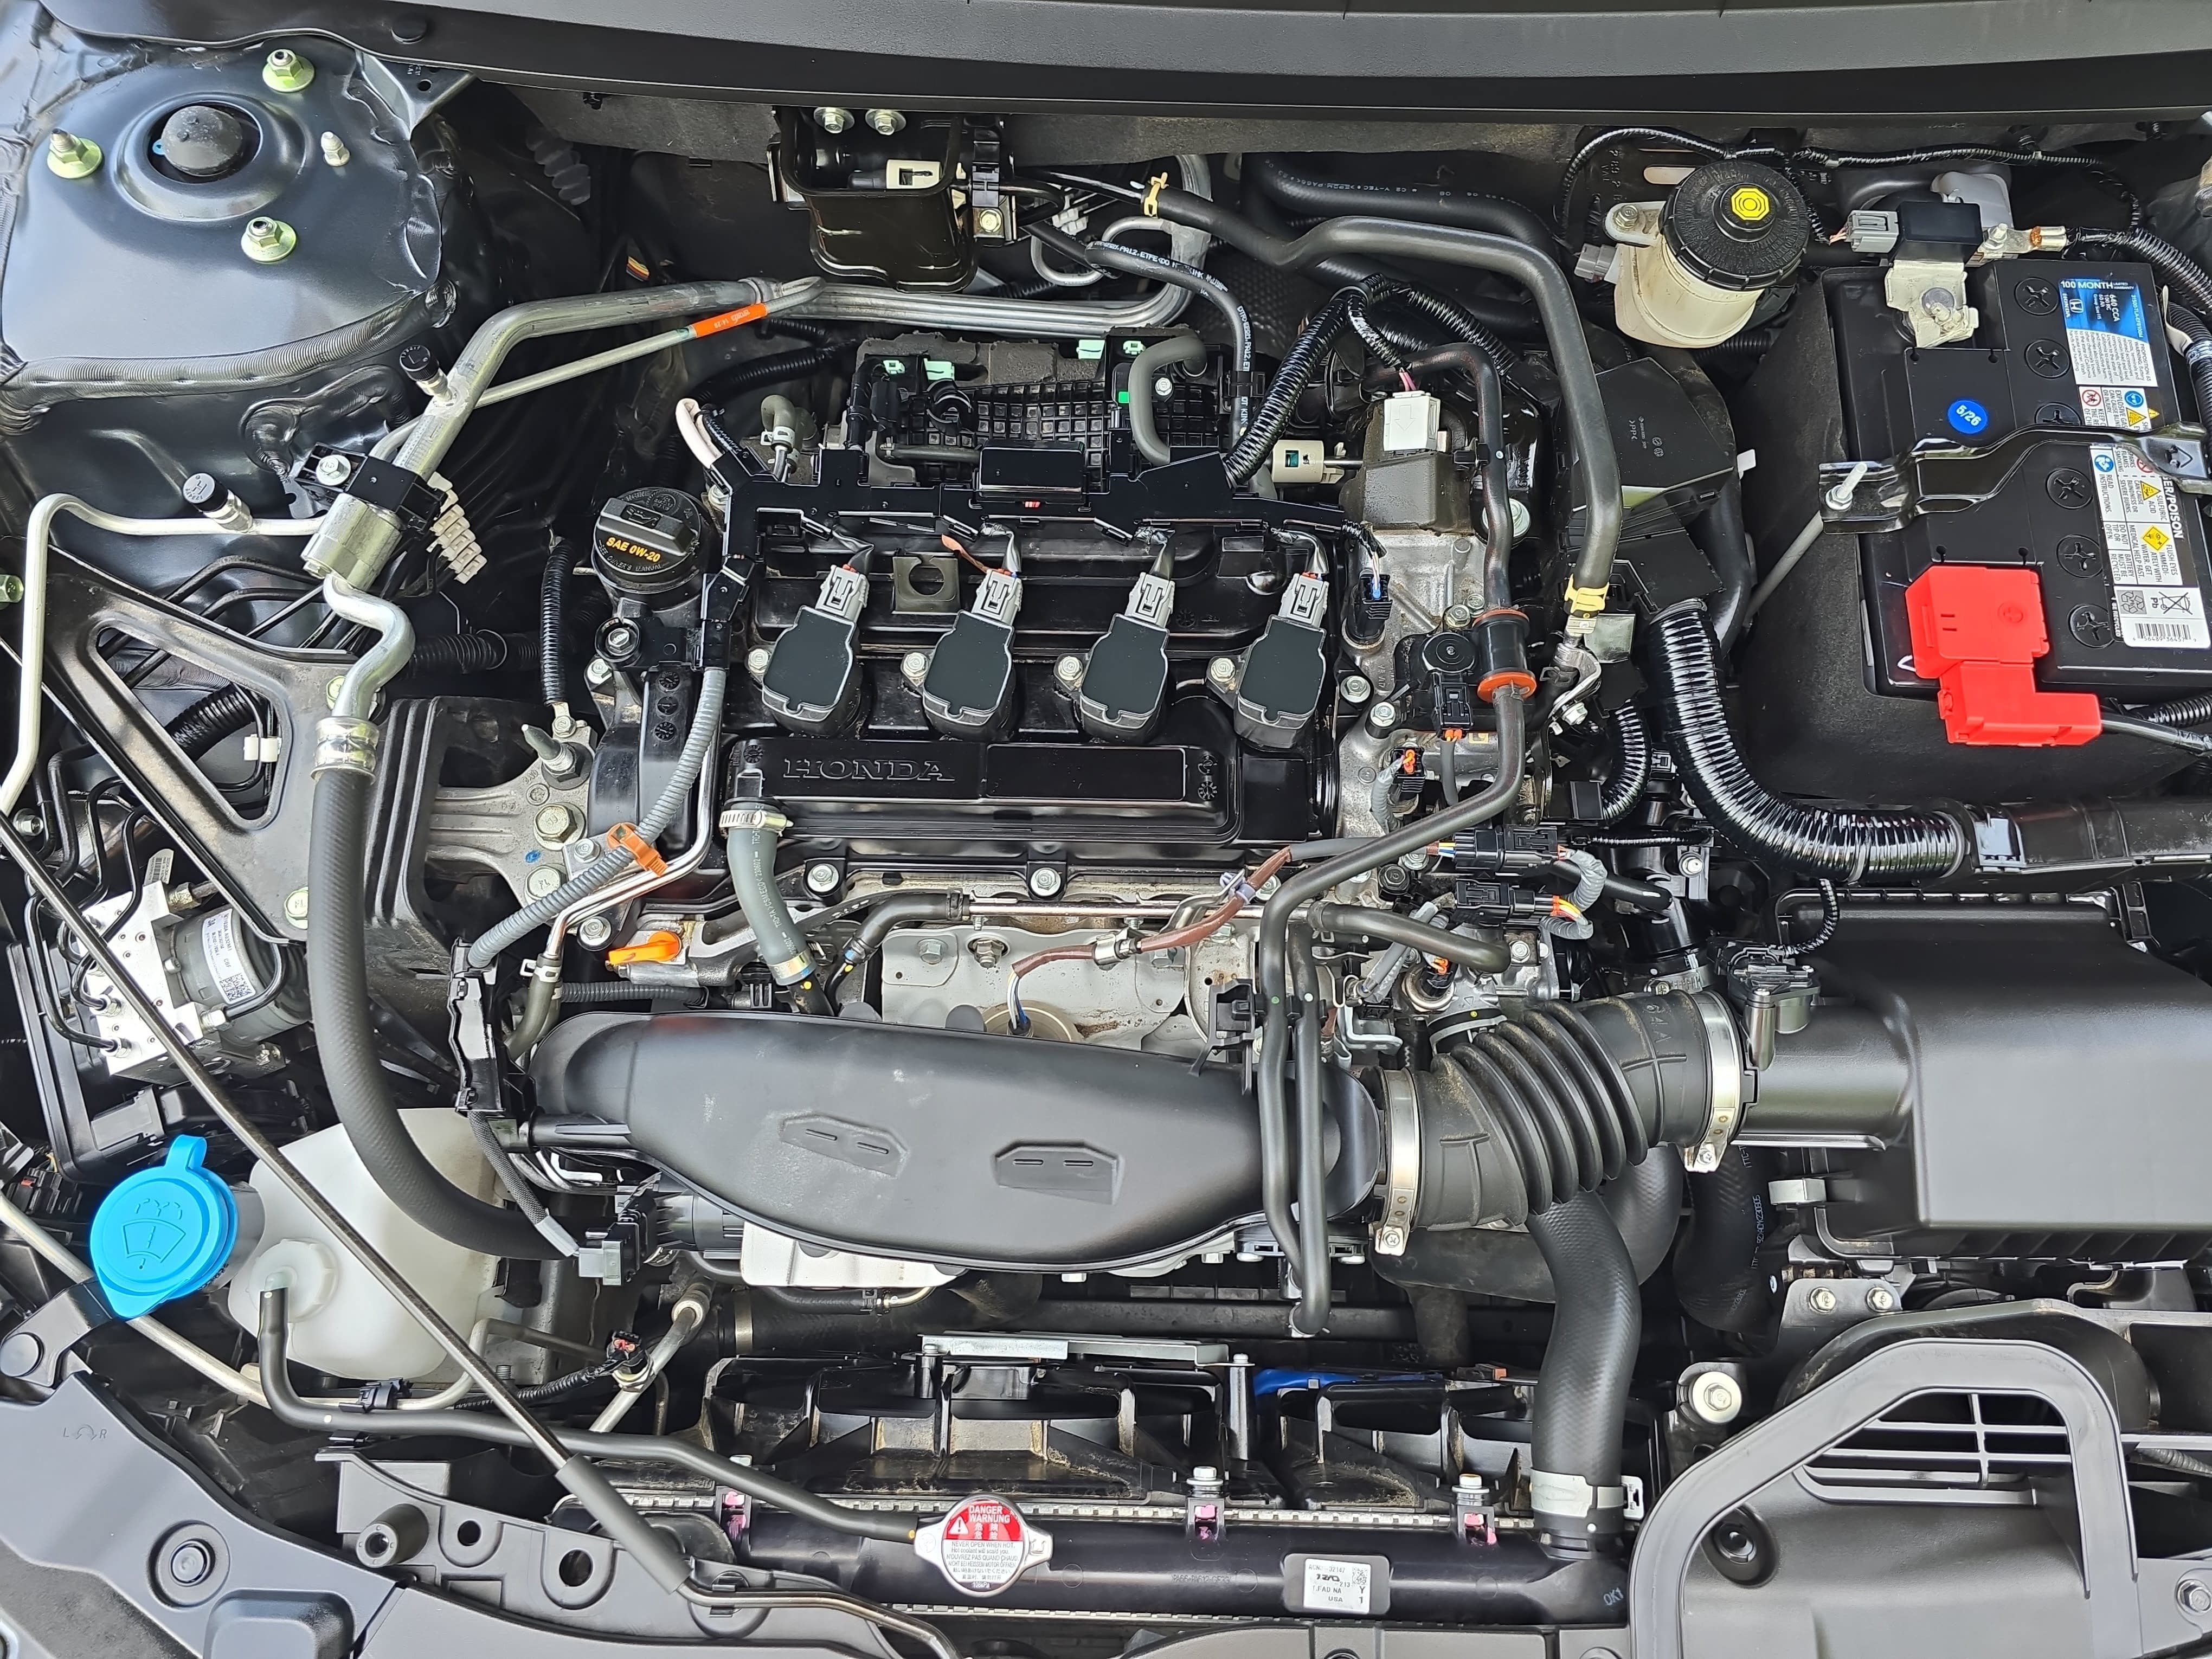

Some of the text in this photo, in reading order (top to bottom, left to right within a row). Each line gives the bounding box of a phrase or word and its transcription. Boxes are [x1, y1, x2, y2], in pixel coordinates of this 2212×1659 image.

[2060, 280, 2113, 289] 100 MONTH
[2061, 293, 2070, 318] HONDA
[2109, 294, 2120, 321] 640 CCA
[2139, 343, 2150, 374] PROPOSITION
[2108, 389, 2119, 414] CAN CAUSE
[2114, 390, 2126, 417] EXPLOSIVE
[1956, 404, 1982, 426] 5/26
[2089, 408, 2098, 418] THE
[2097, 408, 2105, 422] KEEP
[2114, 451, 2124, 472] SMOKING
[2120, 451, 2130, 468] FLAMES
[2105, 474, 2114, 488] READ
[2119, 479, 2129, 496] SEVERE
[2126, 479, 2137, 505] BLINDNESS
[2135, 490, 2144, 505] CAUSE
[2147, 500, 2157, 514] ACID
[2155, 495, 2167, 520] SULFURIC
[2113, 533, 2121, 542] OR
[2118, 524, 2129, 545] DO NOT
[2128, 524, 2139, 549] MEDICAL
[606, 537, 661, 563] SAE 0W-20
[2133, 550, 2142, 564] HELP
[607, 555, 632, 571] OWNER'S
[635, 563, 663, 573] MANUAL
[2110, 554, 2121, 581] RECYCLED
[2116, 554, 2126, 569] MUST
[2124, 554, 2135, 577] BATTERY
[2150, 551, 2163, 582] ATELY WITH
[2158, 552, 2169, 576] IMMEDI-
[2165, 544, 2178, 576] FLUSH EYES
[2144, 565, 2153, 575] GET
[2150, 597, 2159, 608] Pb
[2112, 610, 2121, 637] RECYCLED
[783, 758, 955, 781] HONDA
[206, 918, 217, 928] 3A
[63, 1427, 69, 1437] L
[100, 1429, 107, 1439] R
[969, 1506, 1003, 1515] DANGER
[969, 1514, 1010, 1523] WARNUNG
[1359, 1586, 1366, 1594] Y
